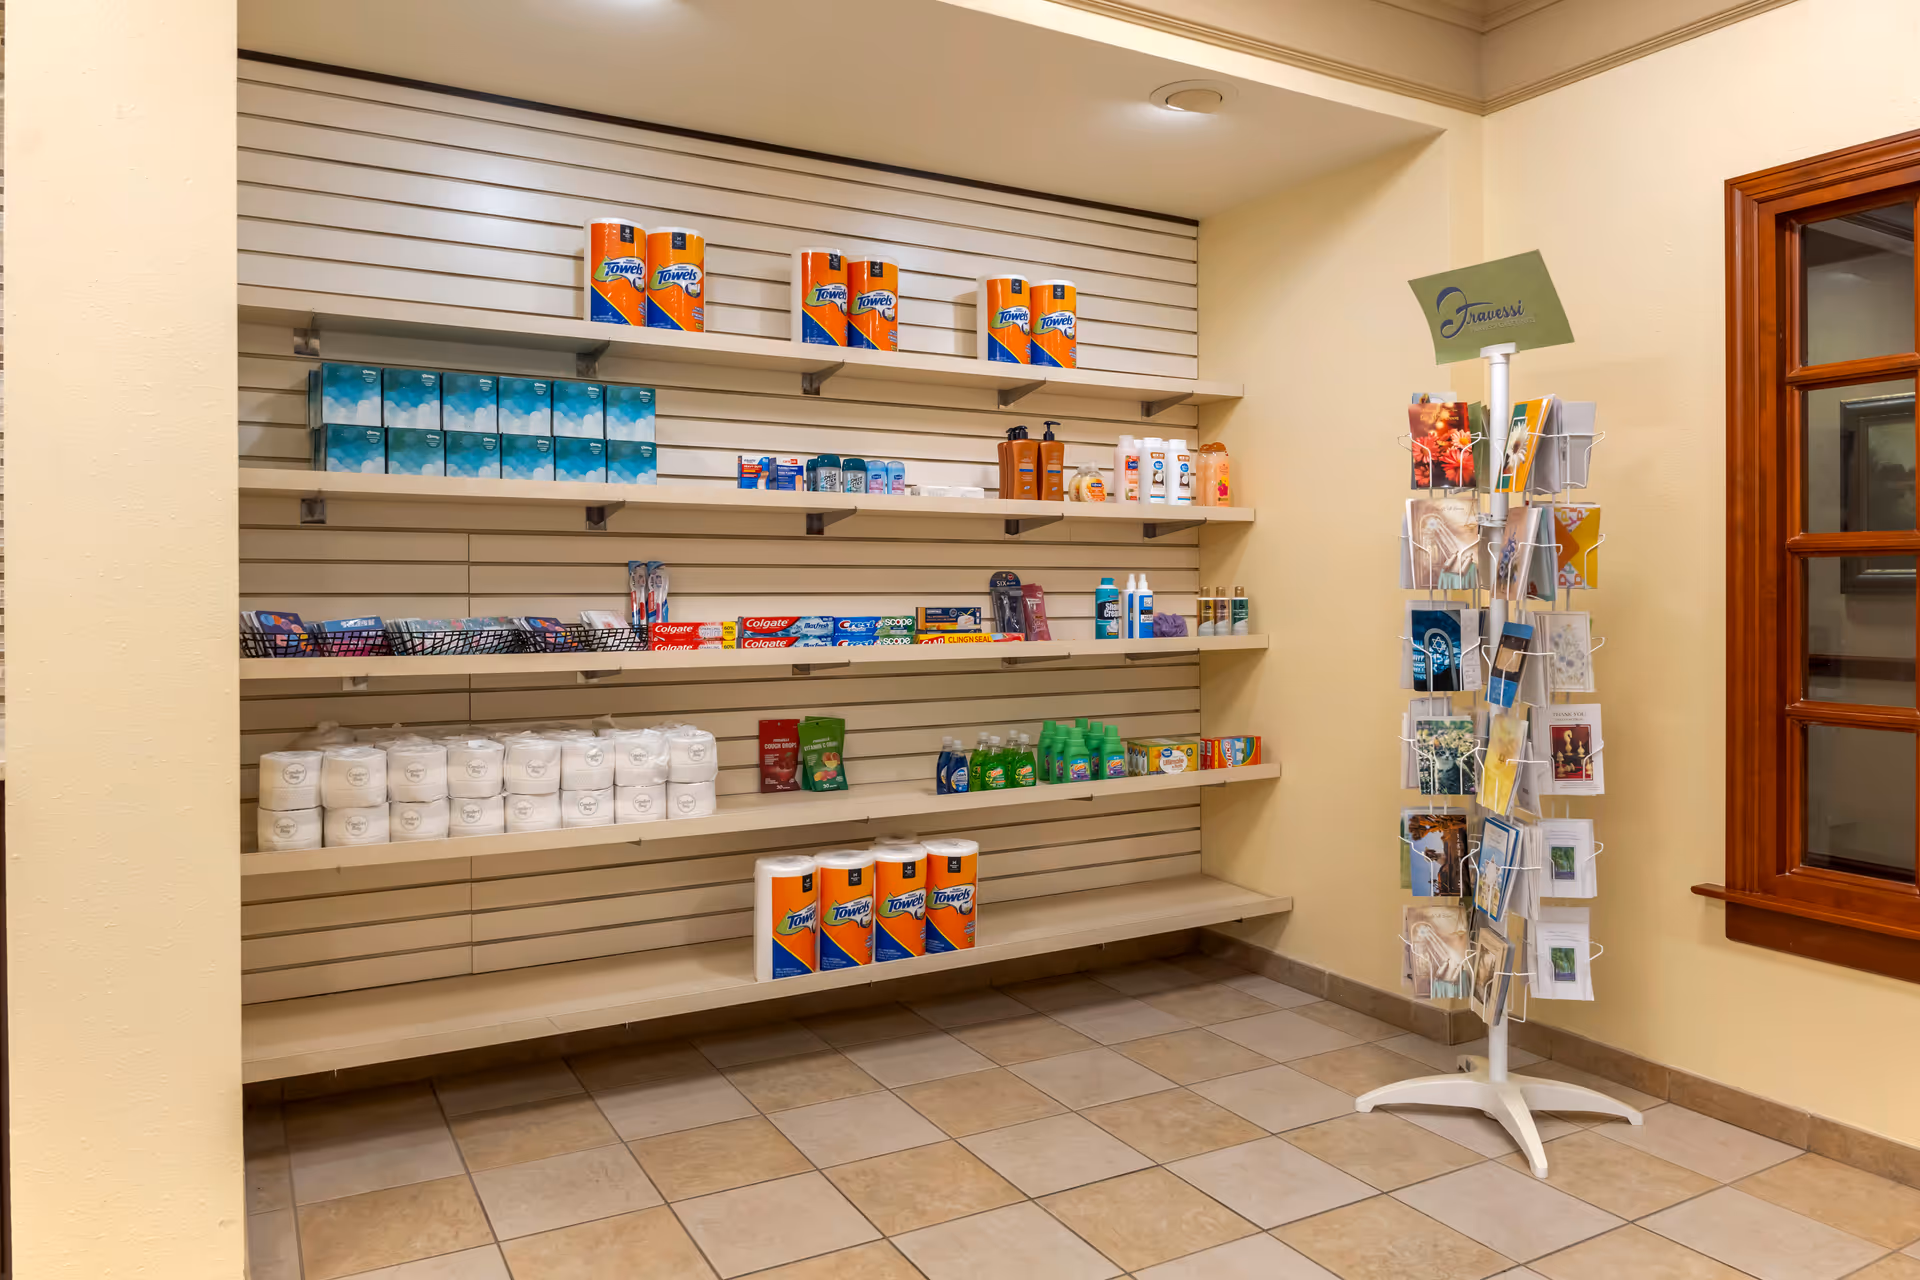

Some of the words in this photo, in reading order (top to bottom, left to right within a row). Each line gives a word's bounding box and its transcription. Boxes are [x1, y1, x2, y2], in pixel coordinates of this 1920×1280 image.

[603, 261, 643, 277] Towels
[657, 269, 698, 285] Towels
[815, 288, 847, 302] Towels
[857, 295, 893, 310] Towels
[998, 310, 1029, 324] Towels
[1436, 286, 1525, 339] Travessi
[1040, 315, 1073, 330] Towels
[654, 625, 693, 635] Colgate
[746, 618, 789, 630] Colgate
[839, 620, 875, 630] Crest
[885, 618, 913, 629] scope
[744, 639, 788, 649] Colgate
[883, 637, 911, 646] scope
[974, 635, 992, 643] SEAL
[764, 742, 782, 750] COUGH
[803, 744, 822, 752] VITAMIN
[887, 894, 924, 913] Towels
[933, 888, 971, 905] Towels
[832, 900, 871, 921] Towels
